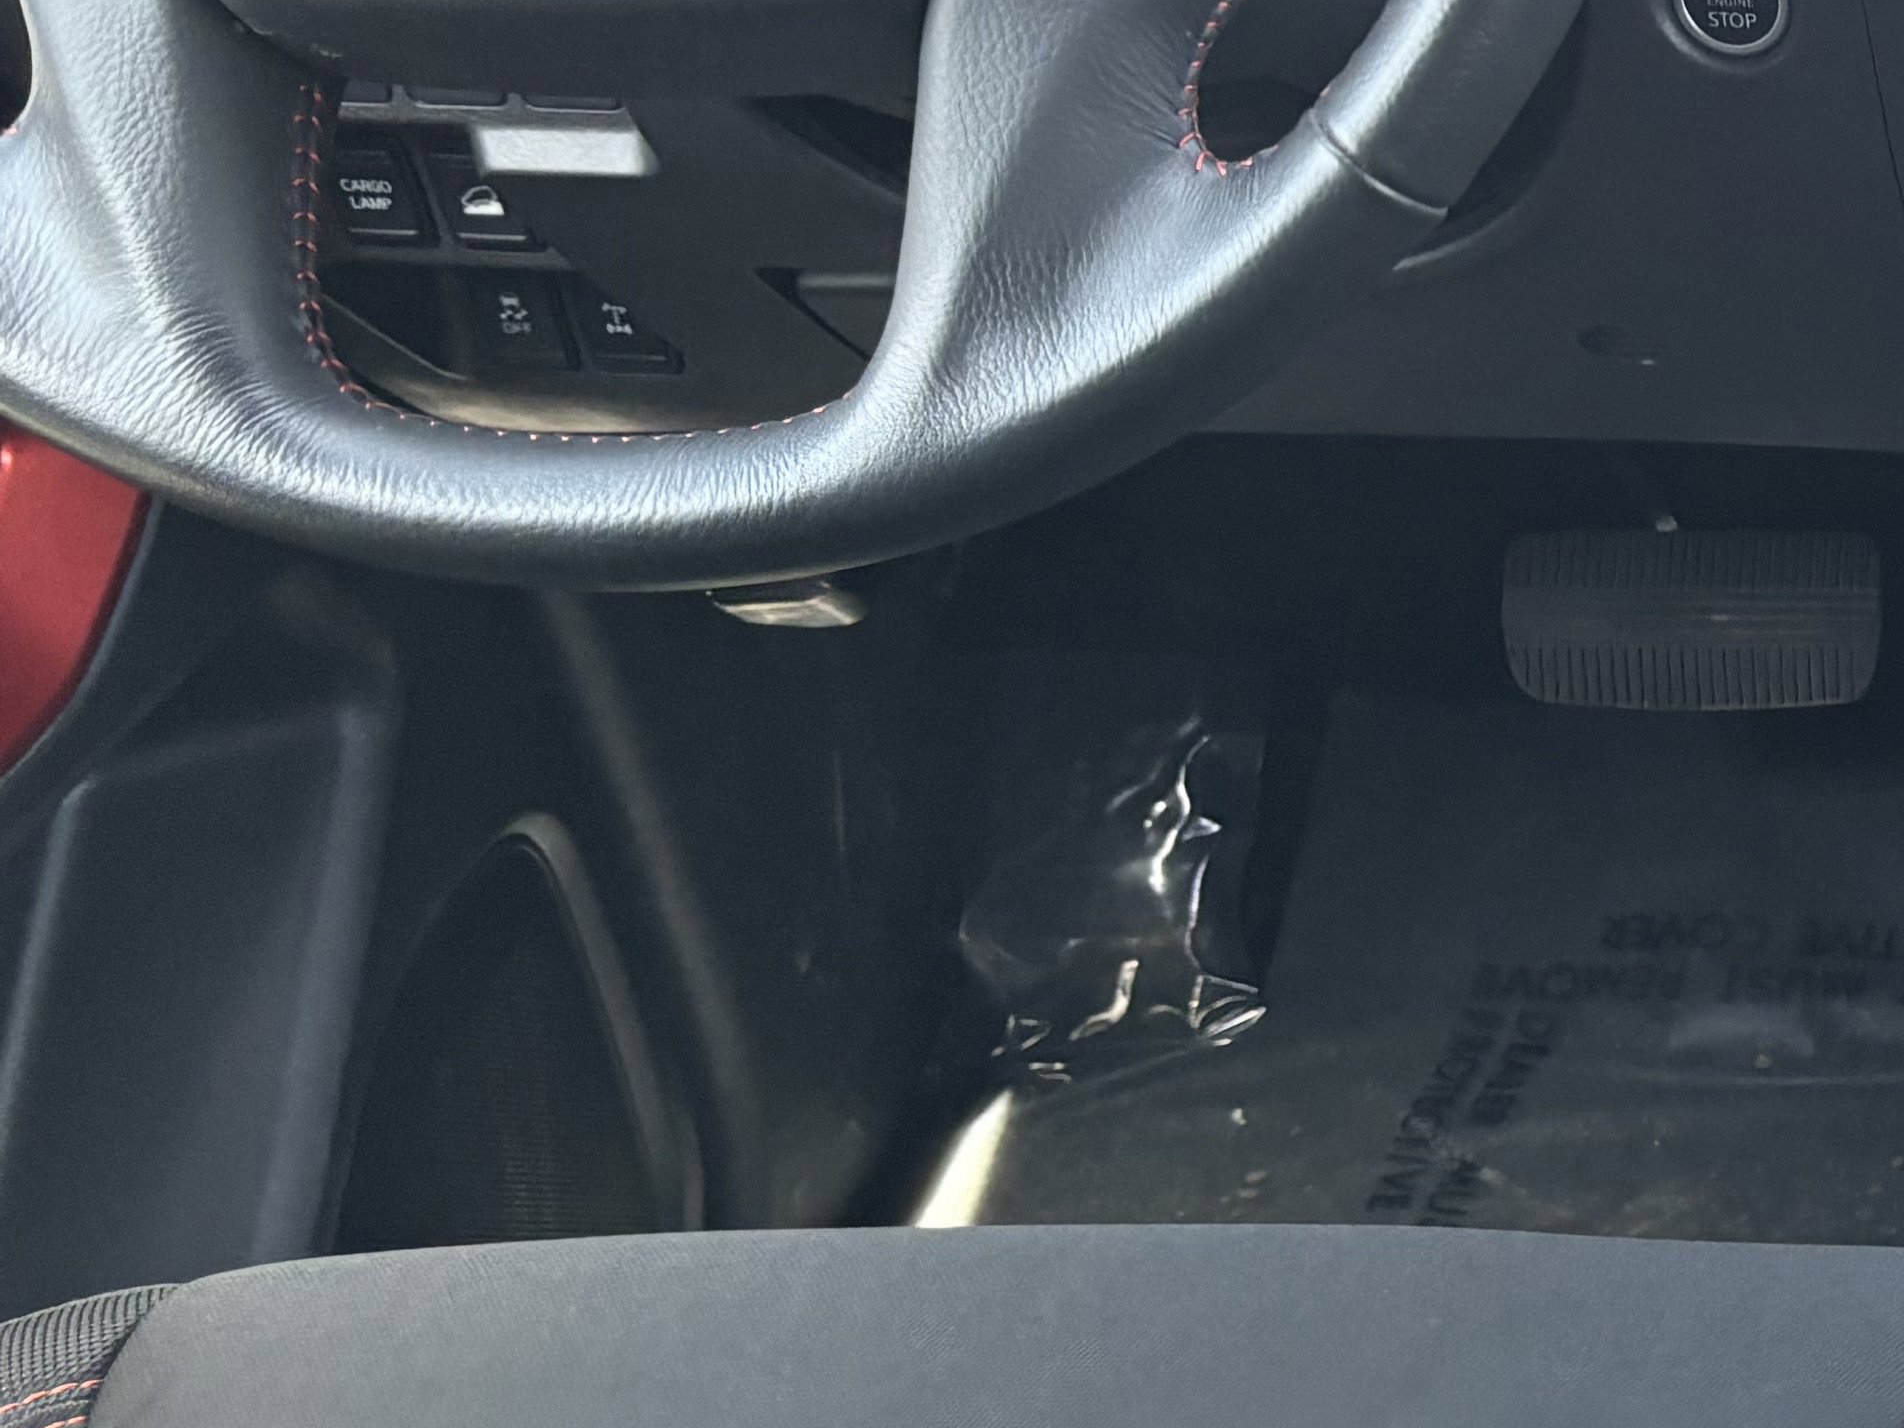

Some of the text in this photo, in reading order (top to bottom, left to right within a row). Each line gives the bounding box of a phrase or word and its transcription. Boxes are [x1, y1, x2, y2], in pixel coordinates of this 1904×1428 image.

[1708, 11, 1757, 30] STOP
[341, 178, 392, 194] CARGO
[350, 196, 391, 211] LAMP
